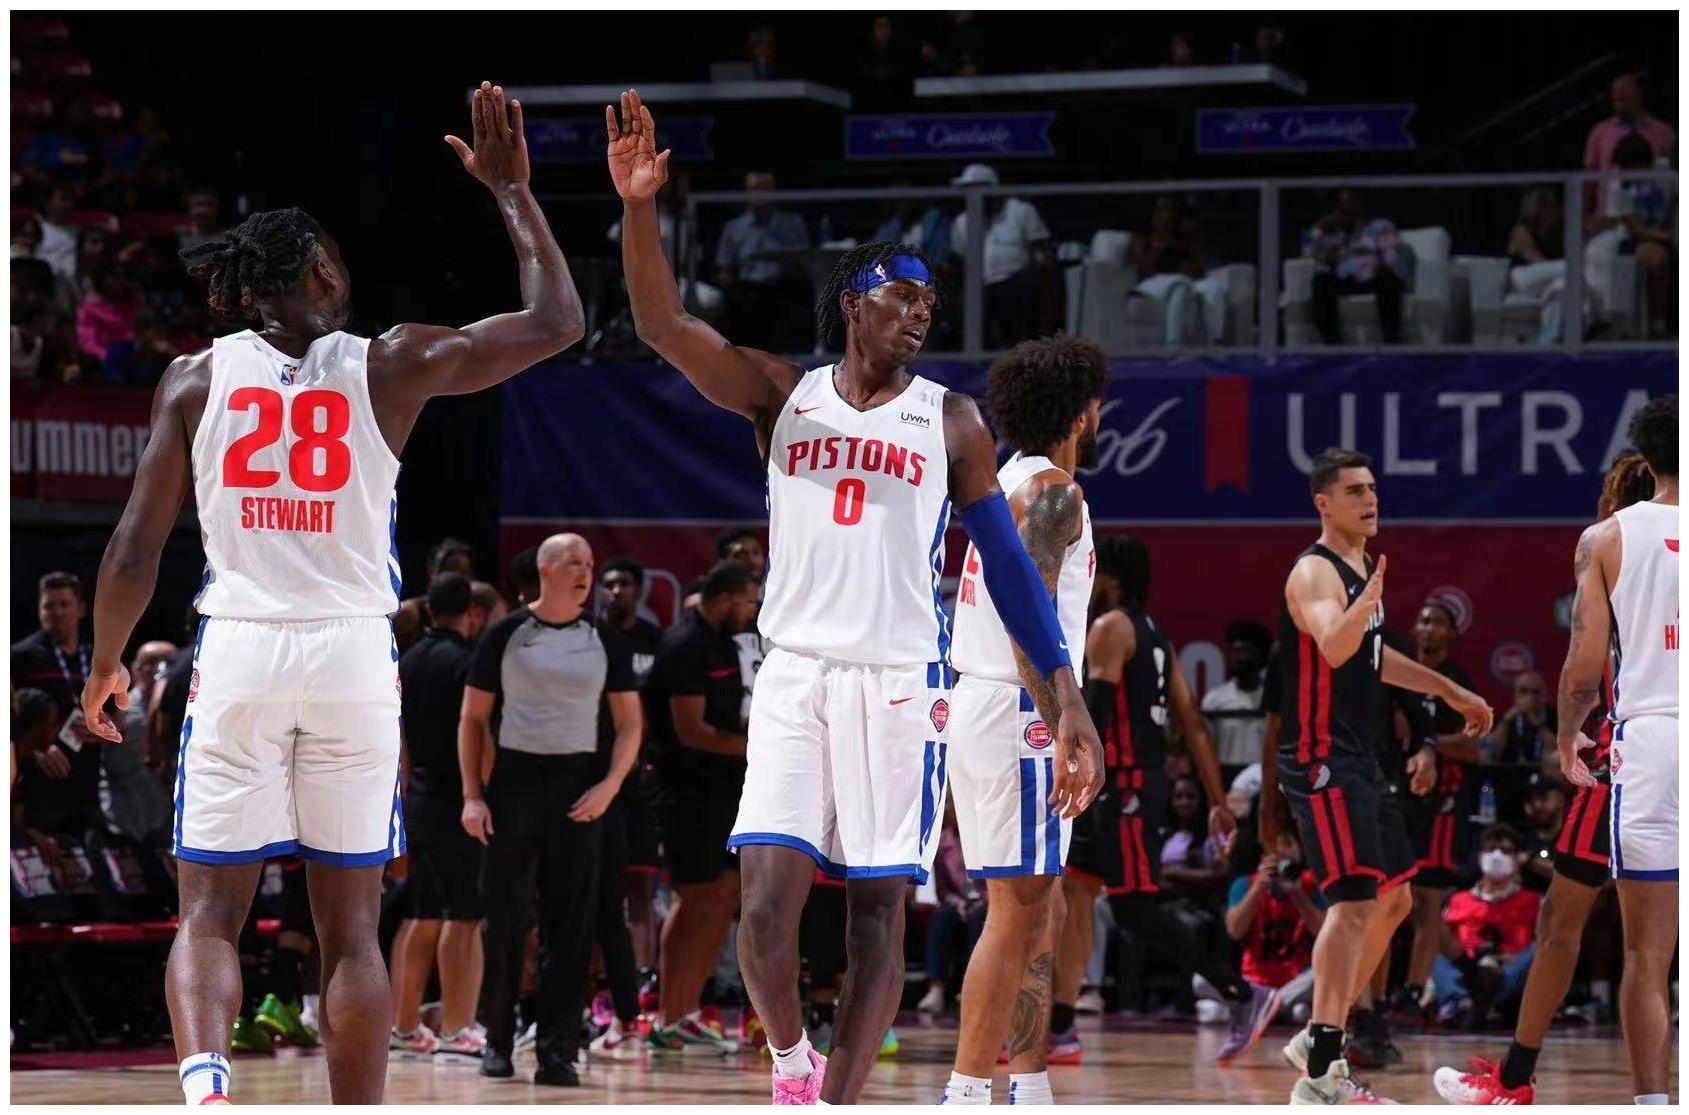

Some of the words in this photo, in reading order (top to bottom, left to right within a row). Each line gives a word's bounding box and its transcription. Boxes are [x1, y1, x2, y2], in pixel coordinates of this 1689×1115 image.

[223, 386, 351, 492] 28
[900, 411, 929, 426] UWM
[787, 437, 926, 488] PISTONS
[241, 496, 335, 533] STEWART
[833, 478, 865, 526] 0
